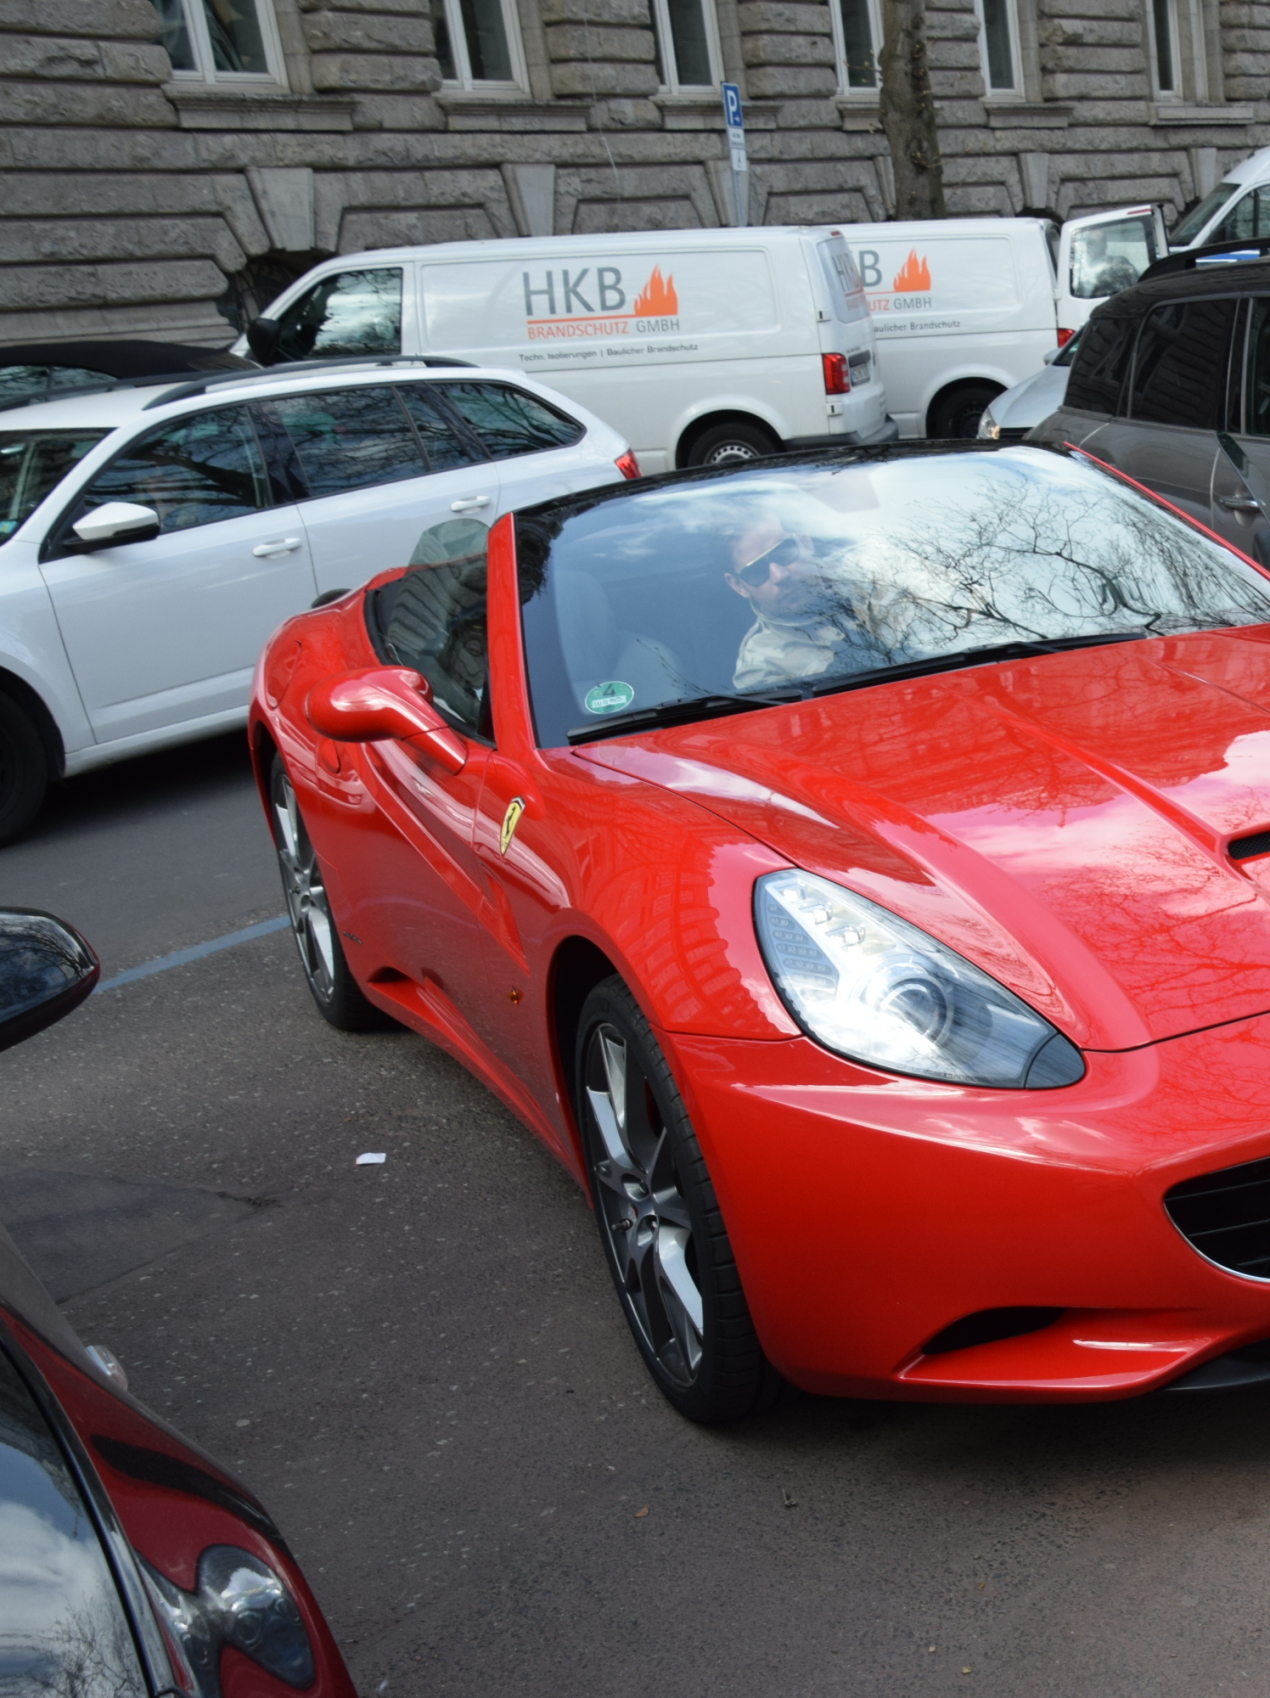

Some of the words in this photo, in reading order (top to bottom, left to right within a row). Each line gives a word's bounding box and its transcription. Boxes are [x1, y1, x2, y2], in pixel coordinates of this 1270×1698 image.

[726, 90, 738, 125] P
[522, 266, 627, 316] HKB
[893, 297, 932, 310] GMBH
[527, 321, 630, 340] BRANDSCHUTZ
[636, 318, 681, 333] GMBH
[874, 323, 907, 333] aulicher
[910, 320, 961, 331] Brandschutz
[519, 353, 546, 362] Techn.
[547, 349, 597, 361] Isolierungen
[606, 346, 644, 357] Baulicher
[647, 342, 699, 354] Brandschutz
[602, 683, 616, 697] 4
